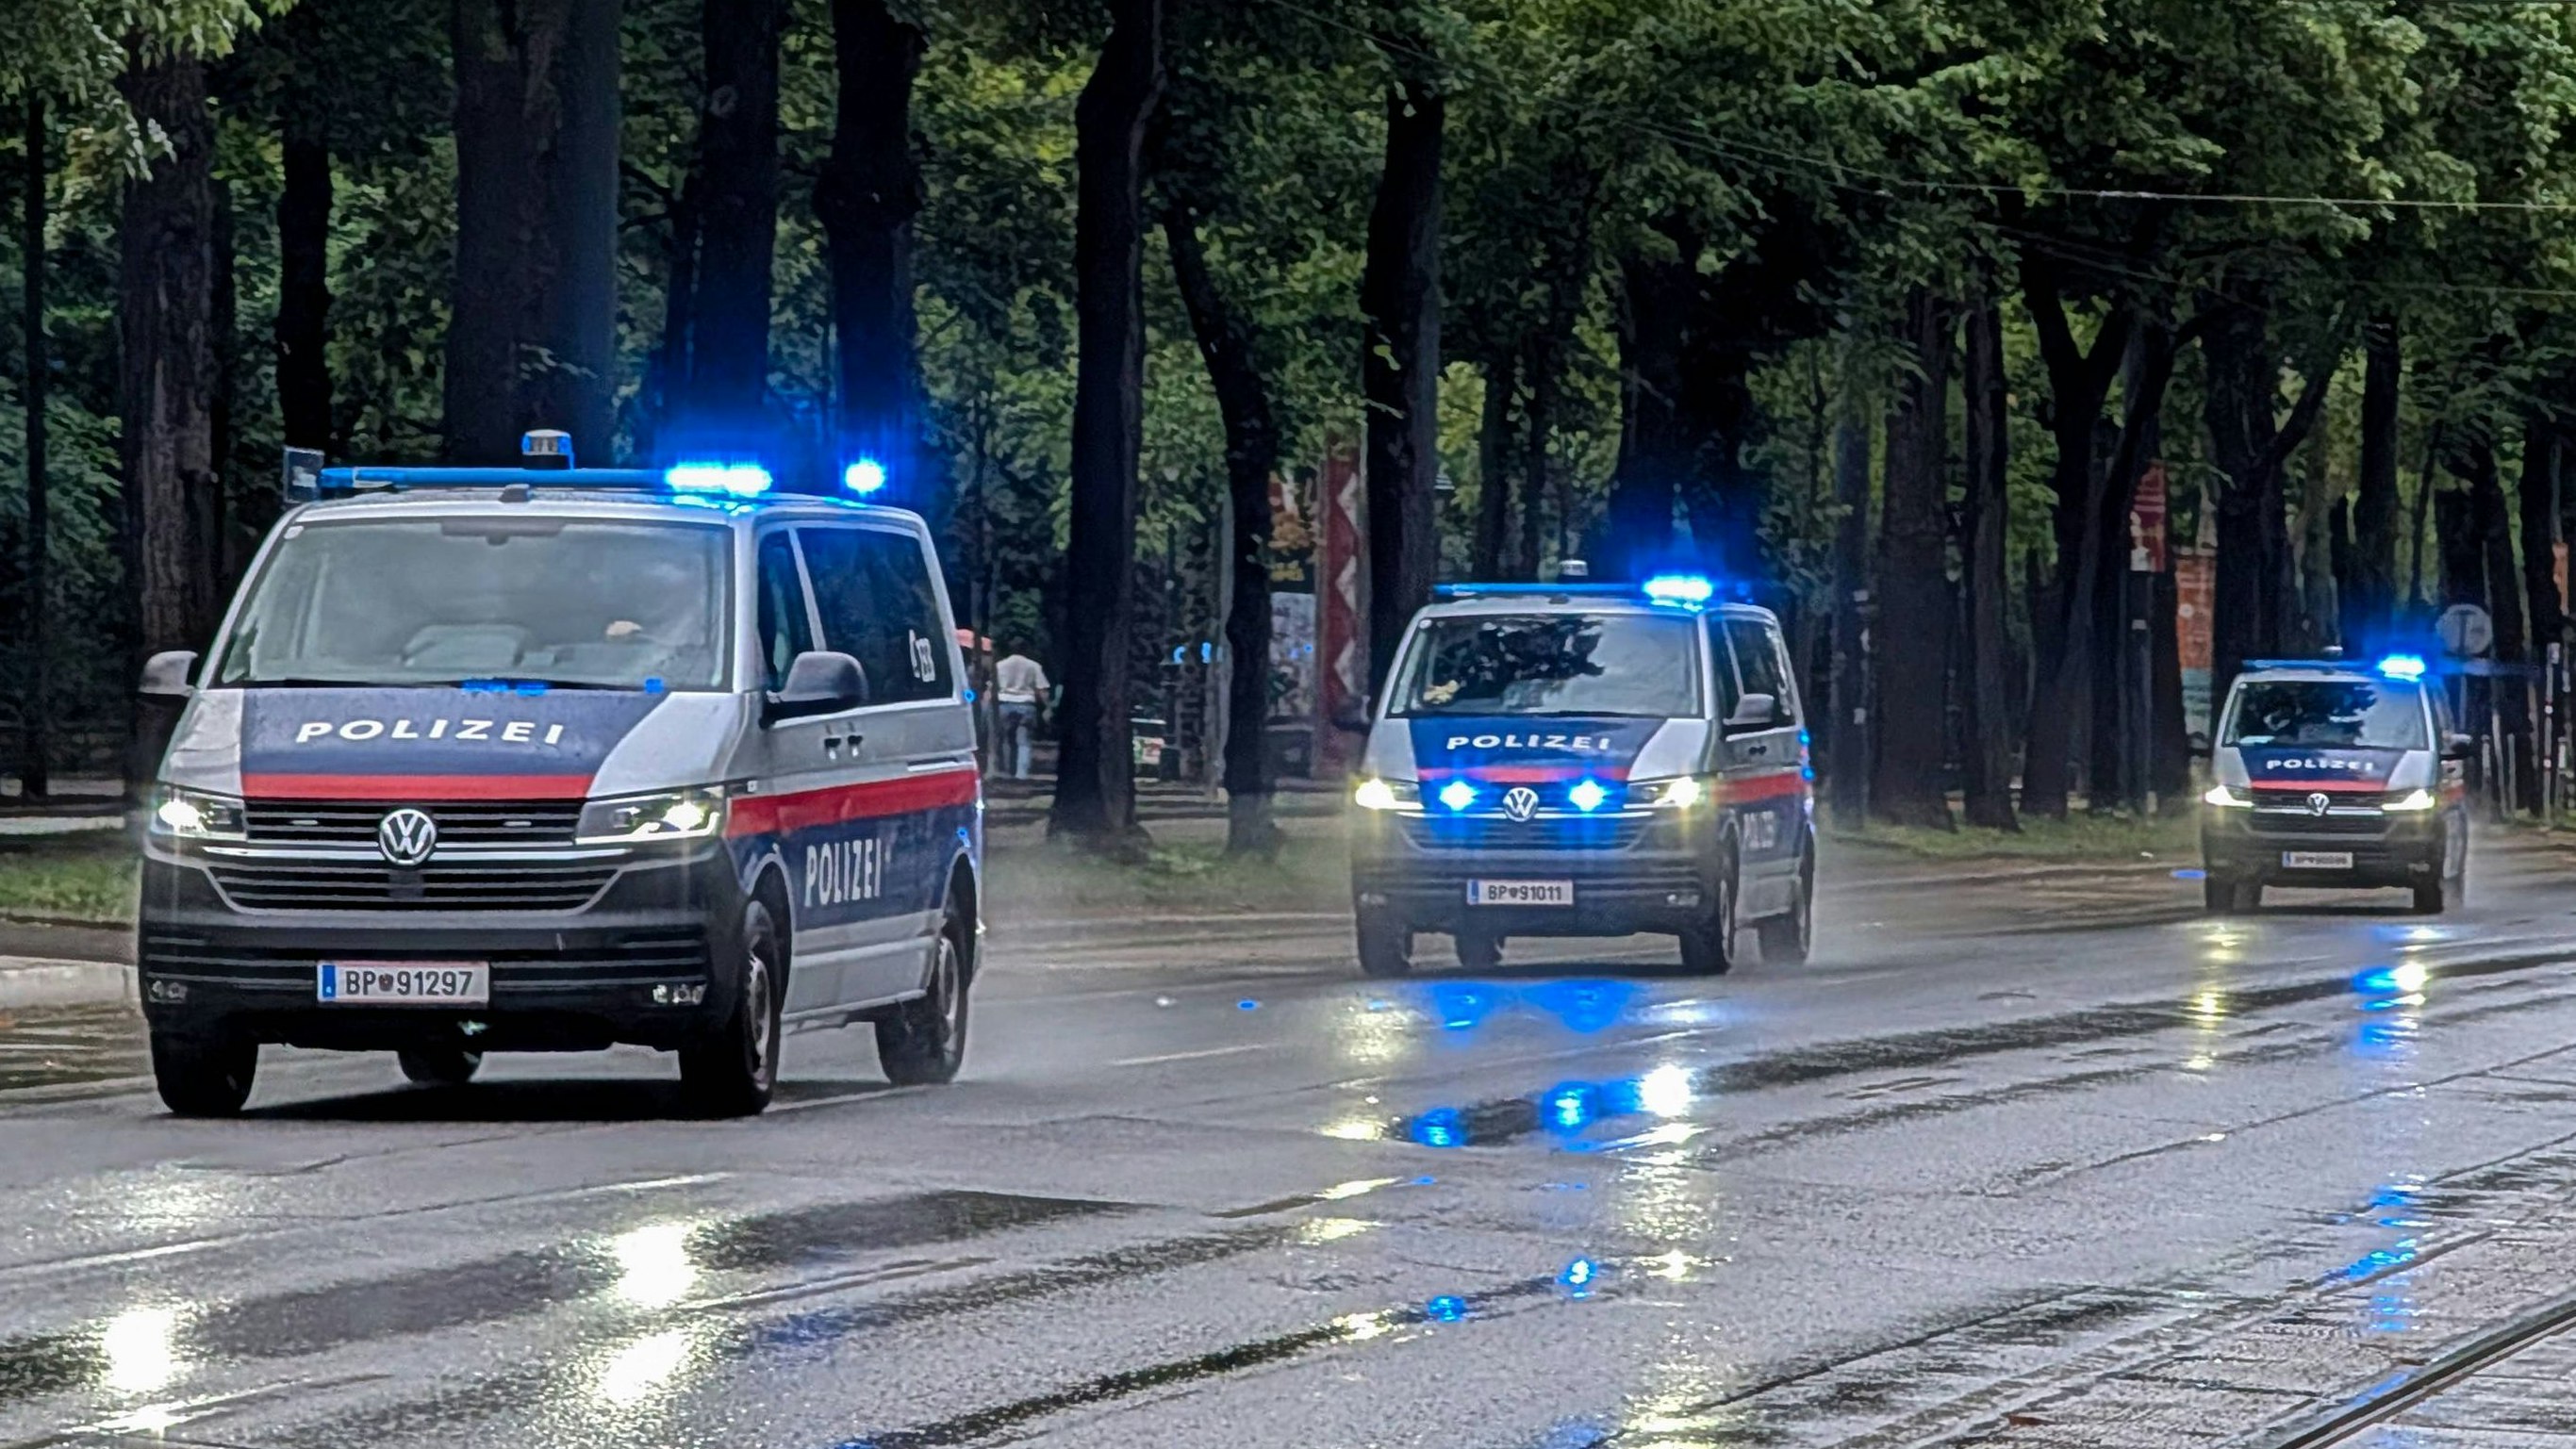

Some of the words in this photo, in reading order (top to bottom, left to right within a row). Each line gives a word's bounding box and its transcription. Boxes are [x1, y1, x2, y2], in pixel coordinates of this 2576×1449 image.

[296, 719, 564, 744] POLIZEI
[1446, 734, 1610, 750] POLIZEI
[2267, 759, 2373, 770] POLIZEI
[804, 837, 882, 908] POLIZEI
[1488, 884, 1507, 900] BP
[1519, 884, 1561, 901] 91011
[345, 970, 376, 996] BP
[397, 970, 473, 996] 91297
